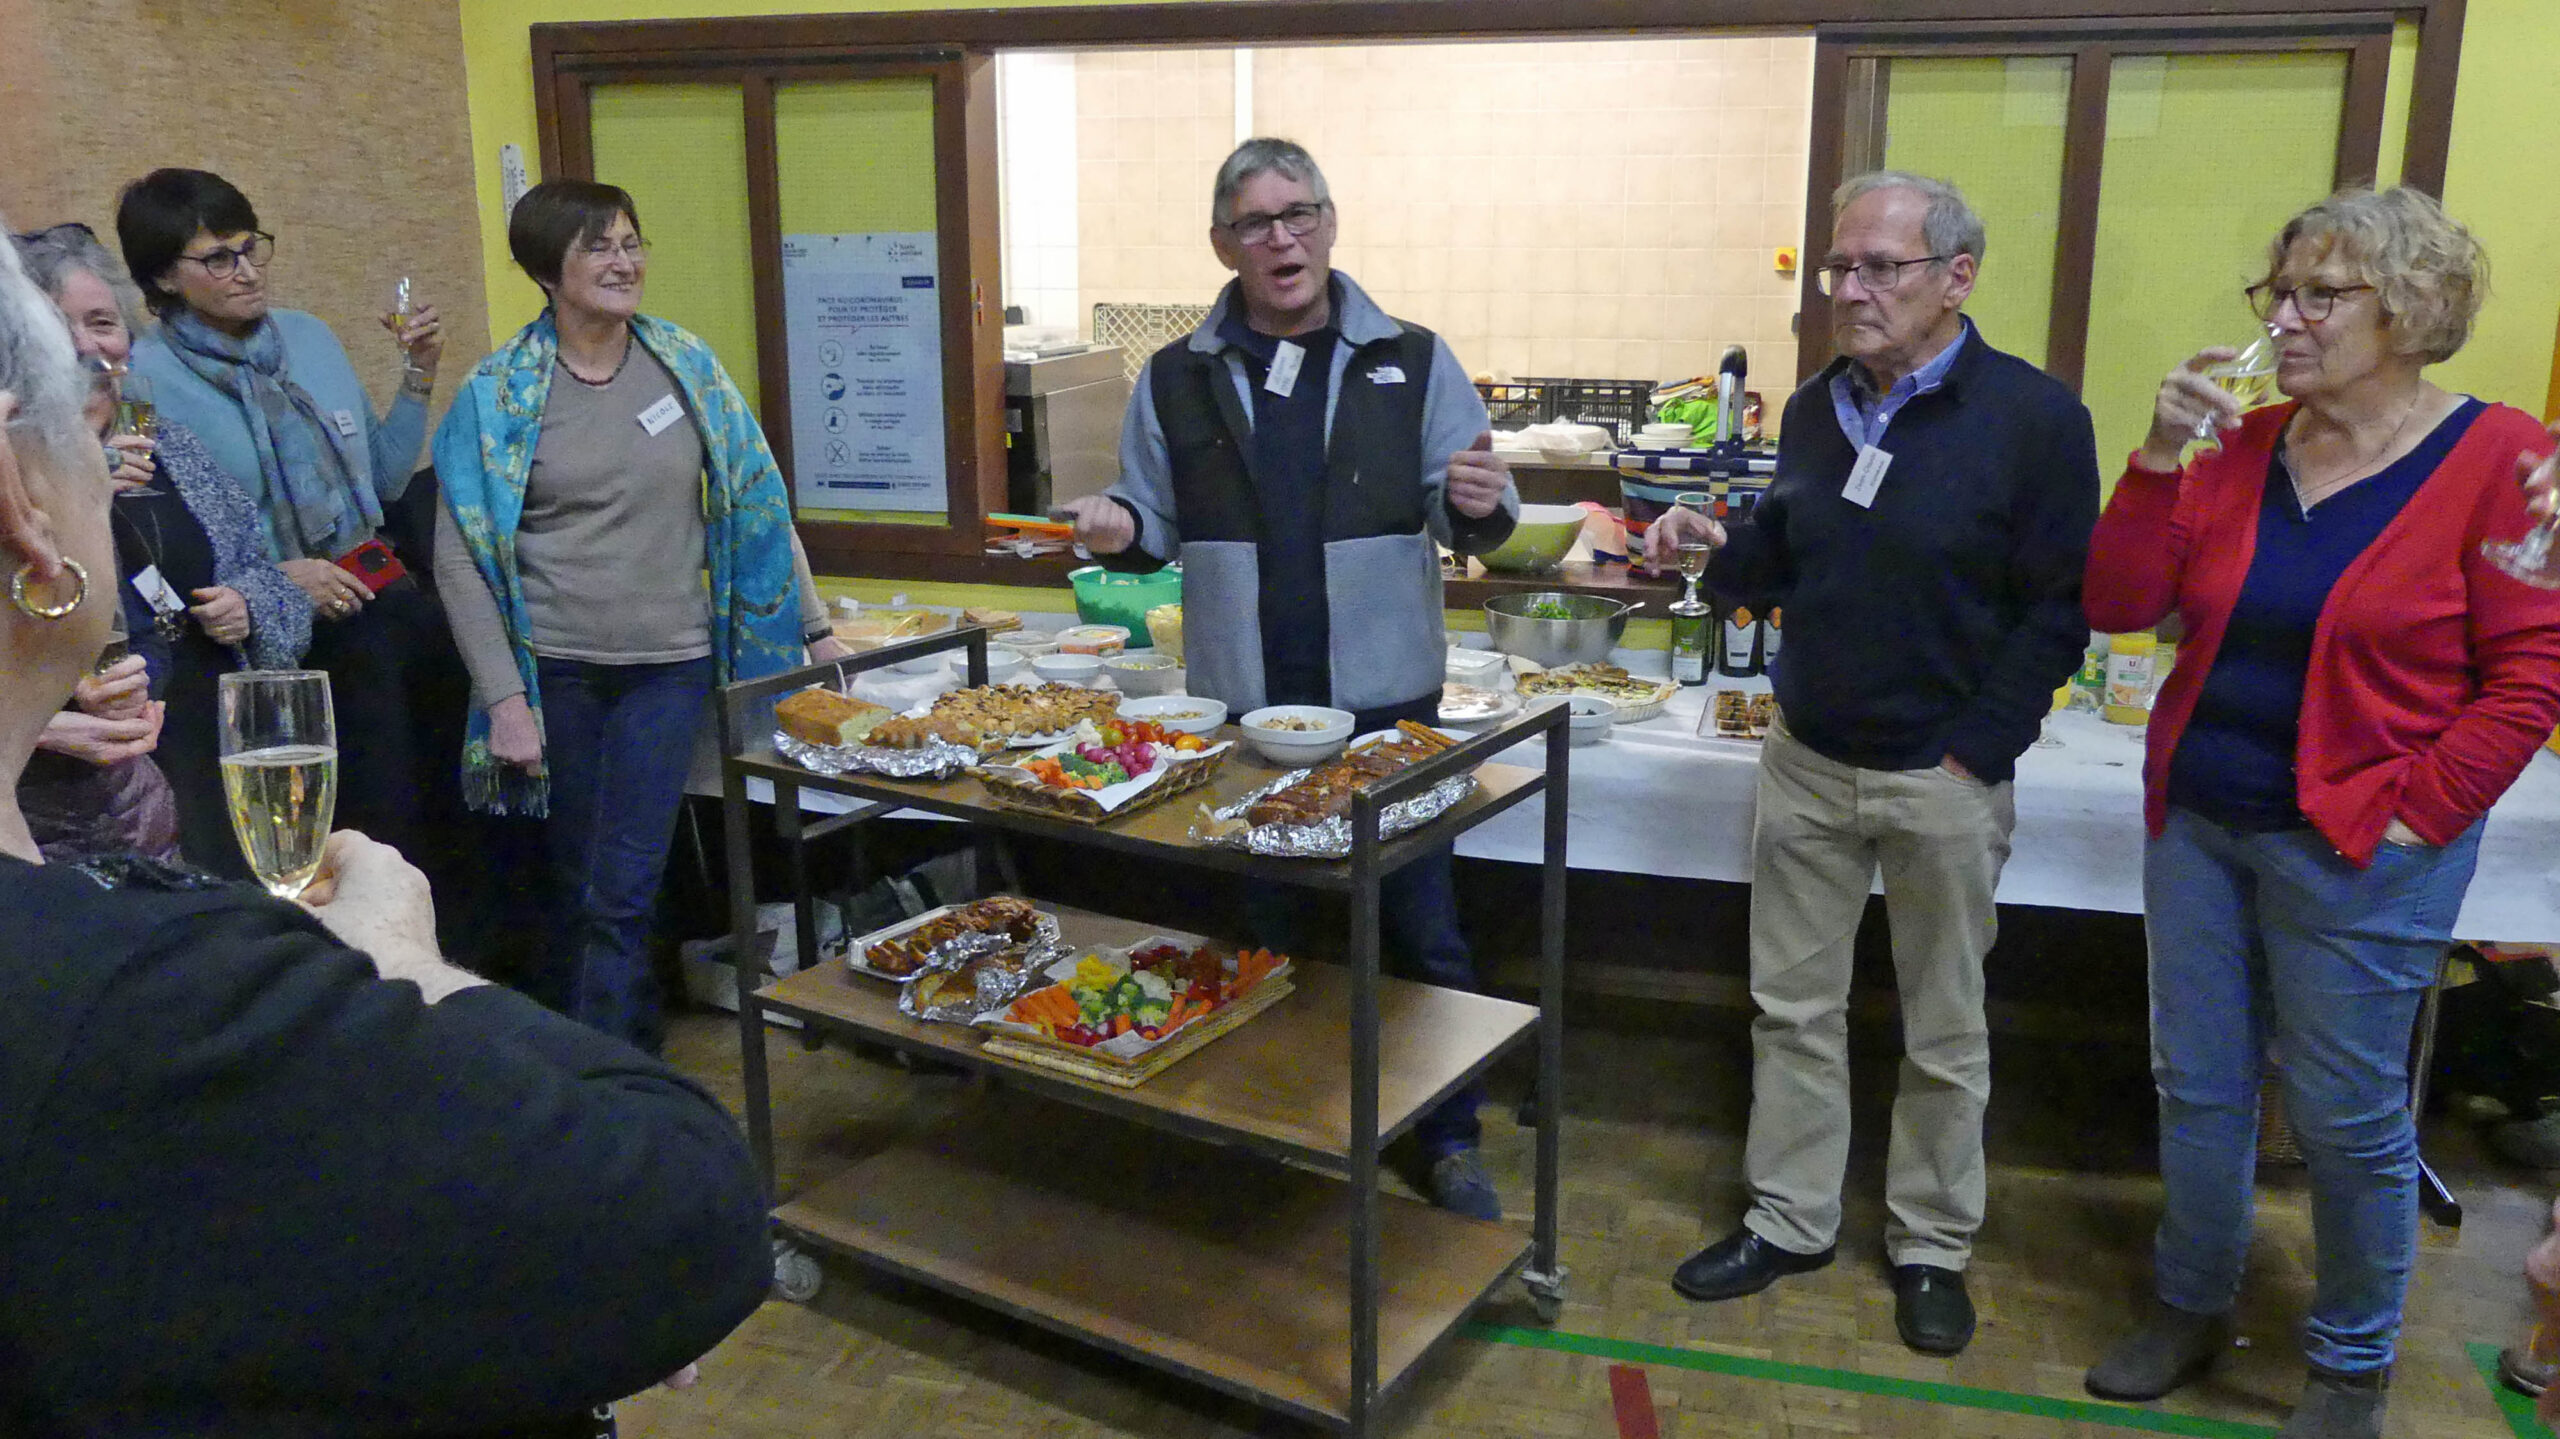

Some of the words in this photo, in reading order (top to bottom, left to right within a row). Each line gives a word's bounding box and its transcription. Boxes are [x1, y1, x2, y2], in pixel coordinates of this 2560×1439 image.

[817, 296, 836, 304] FACE
[849, 296, 903, 304] CORONAVIRUS
[828, 305, 848, 313] POUR
[860, 304, 898, 313] PROTÉGER
[867, 314, 879, 322] LES
[880, 314, 910, 323] AUTRES
[646, 404, 674, 425] NICOLE
